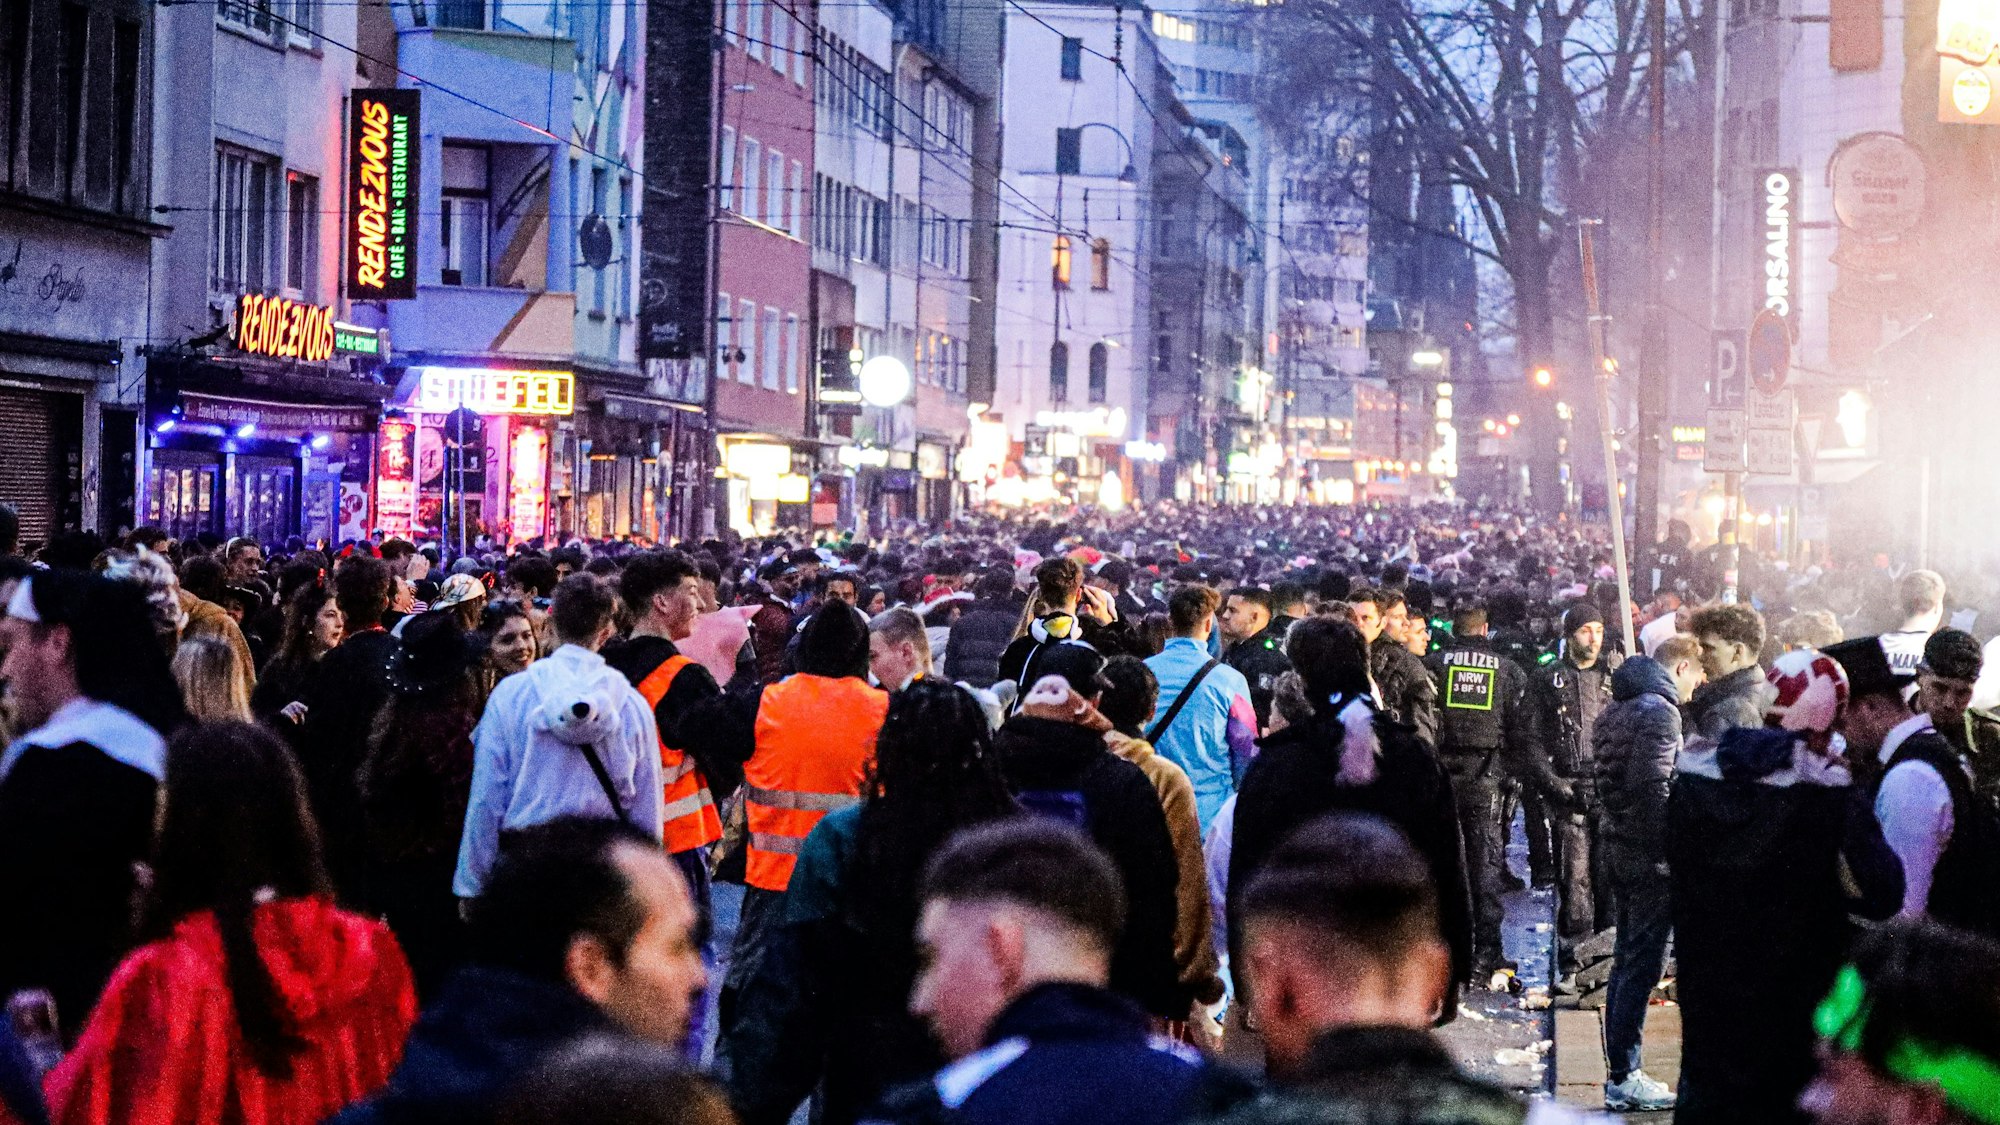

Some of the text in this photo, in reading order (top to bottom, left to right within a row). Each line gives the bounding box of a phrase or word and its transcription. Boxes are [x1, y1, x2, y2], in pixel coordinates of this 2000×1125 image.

[358, 99, 389, 289] RENDEZVOUS
[388, 114, 408, 279] CAFÉ BAR RESTAURANT
[1766, 173, 1790, 317] ORSALINO
[239, 294, 334, 362] RENDEZVOUS
[1443, 651, 1499, 669] POLIZEI
[1453, 683, 1487, 695] 3 BF 13
[1458, 672, 1484, 684] NRW
